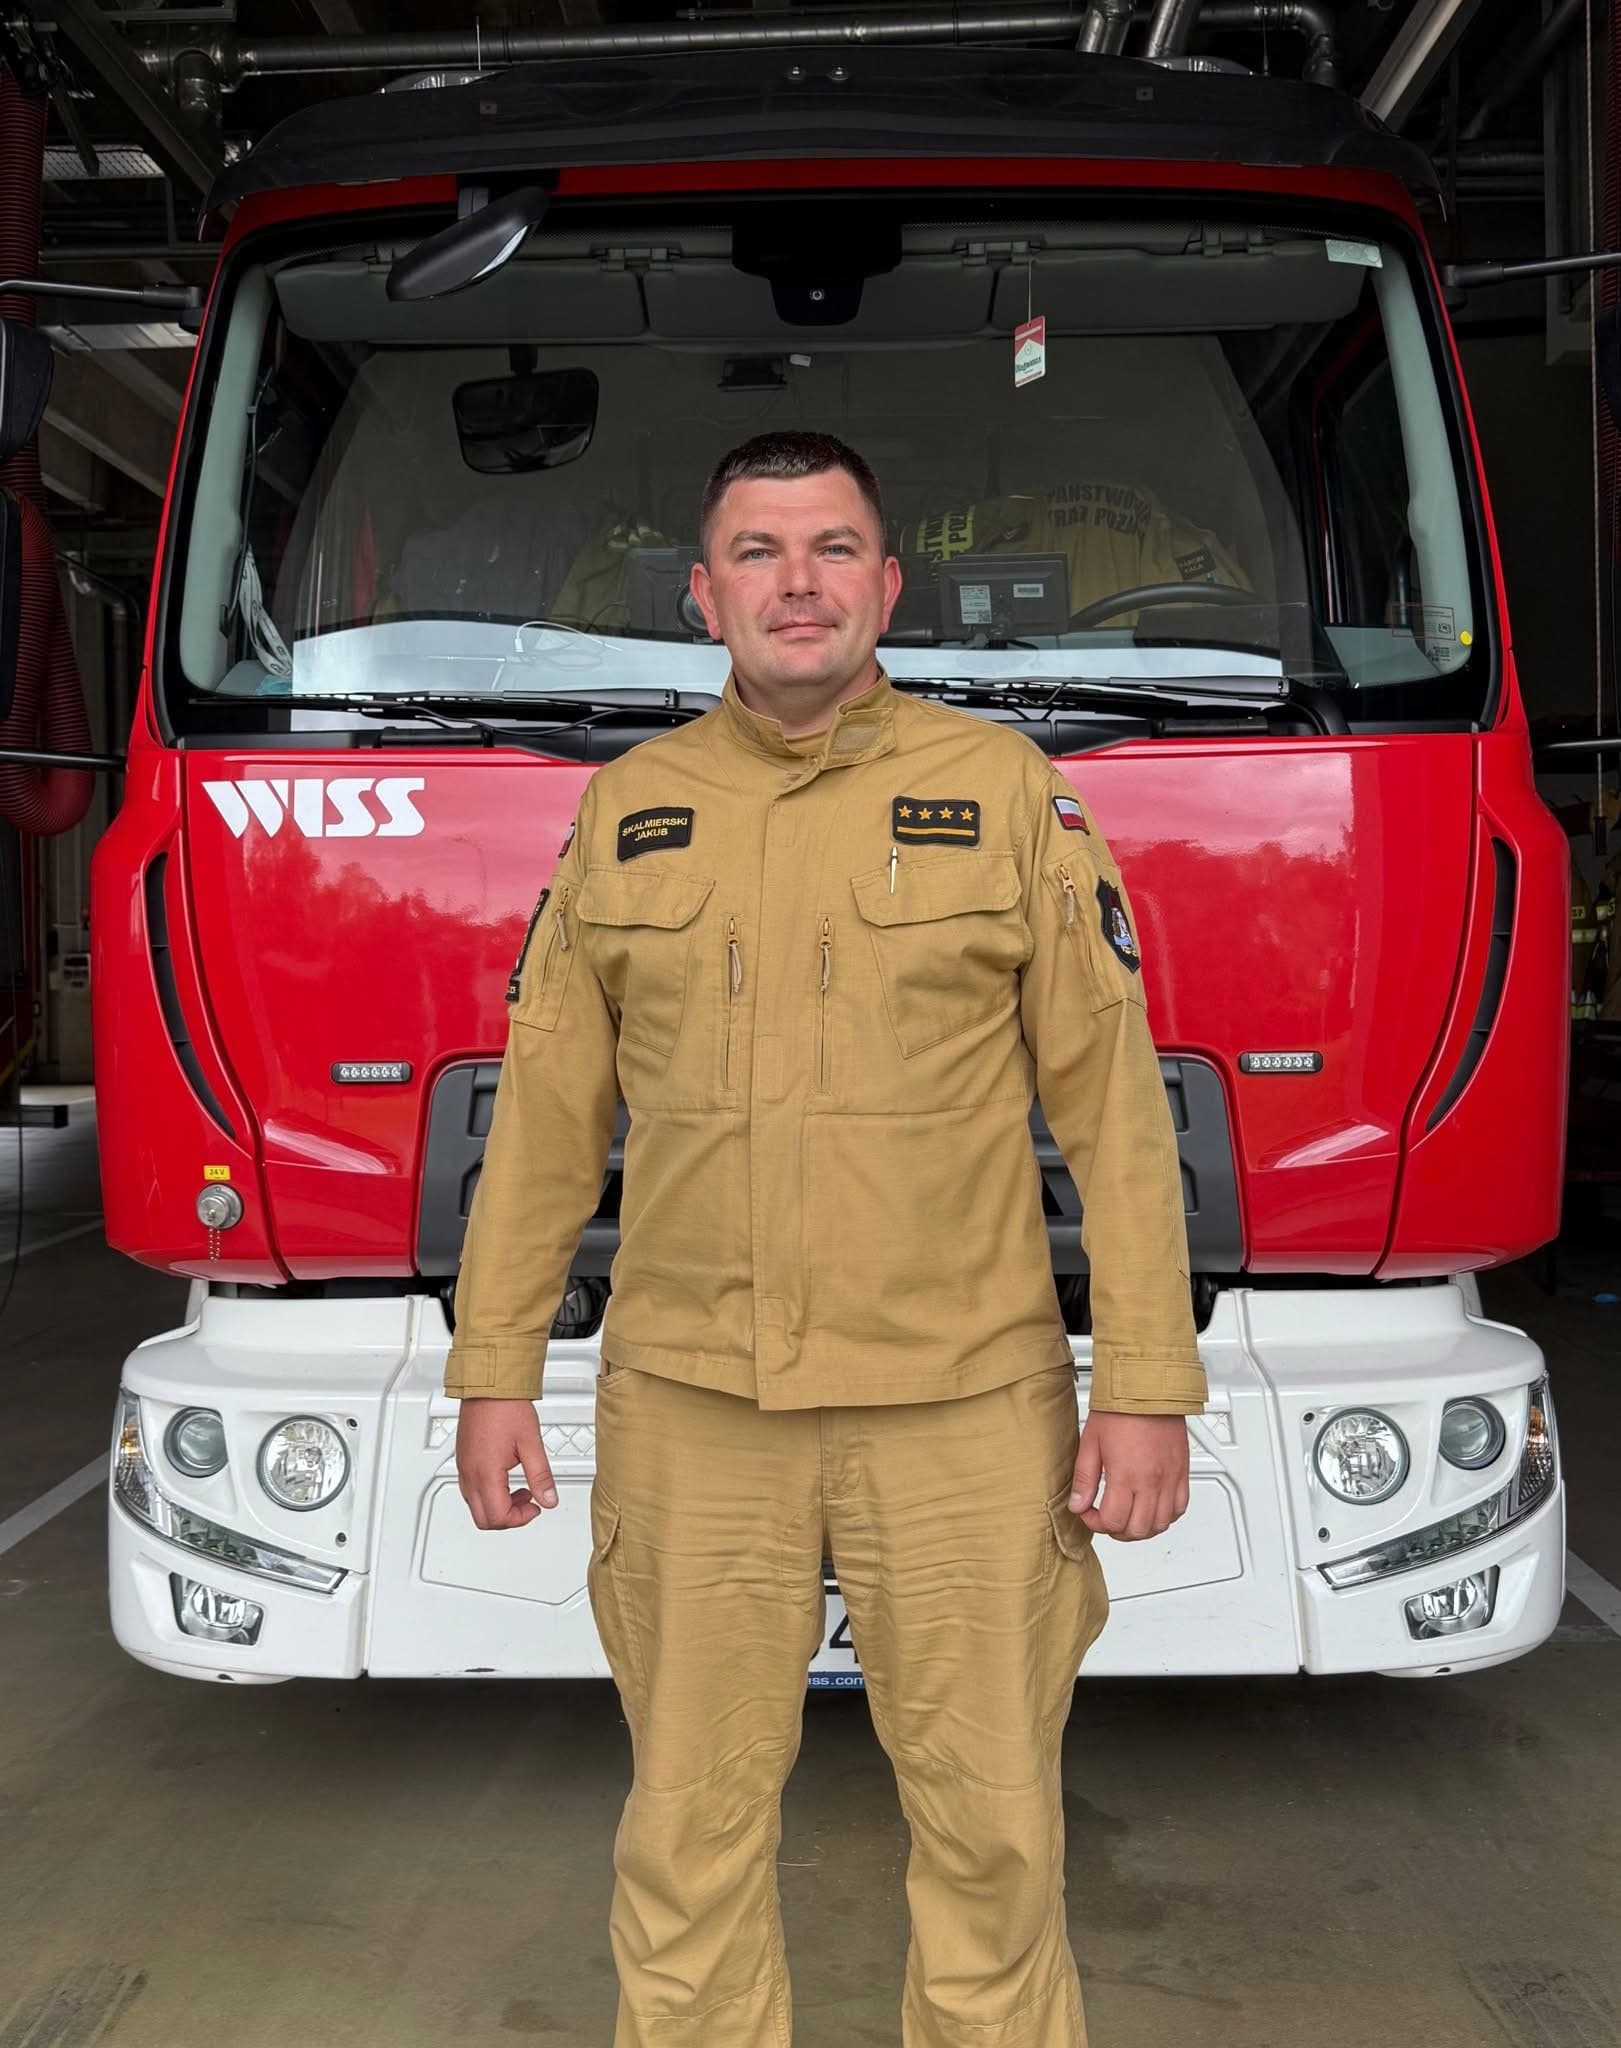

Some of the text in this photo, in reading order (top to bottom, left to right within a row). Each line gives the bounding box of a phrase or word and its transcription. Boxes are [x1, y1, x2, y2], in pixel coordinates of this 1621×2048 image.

[201, 778, 425, 839] WISS
[622, 817, 688, 837] SKALMIERSKI
[634, 827, 669, 842] JAKUB
